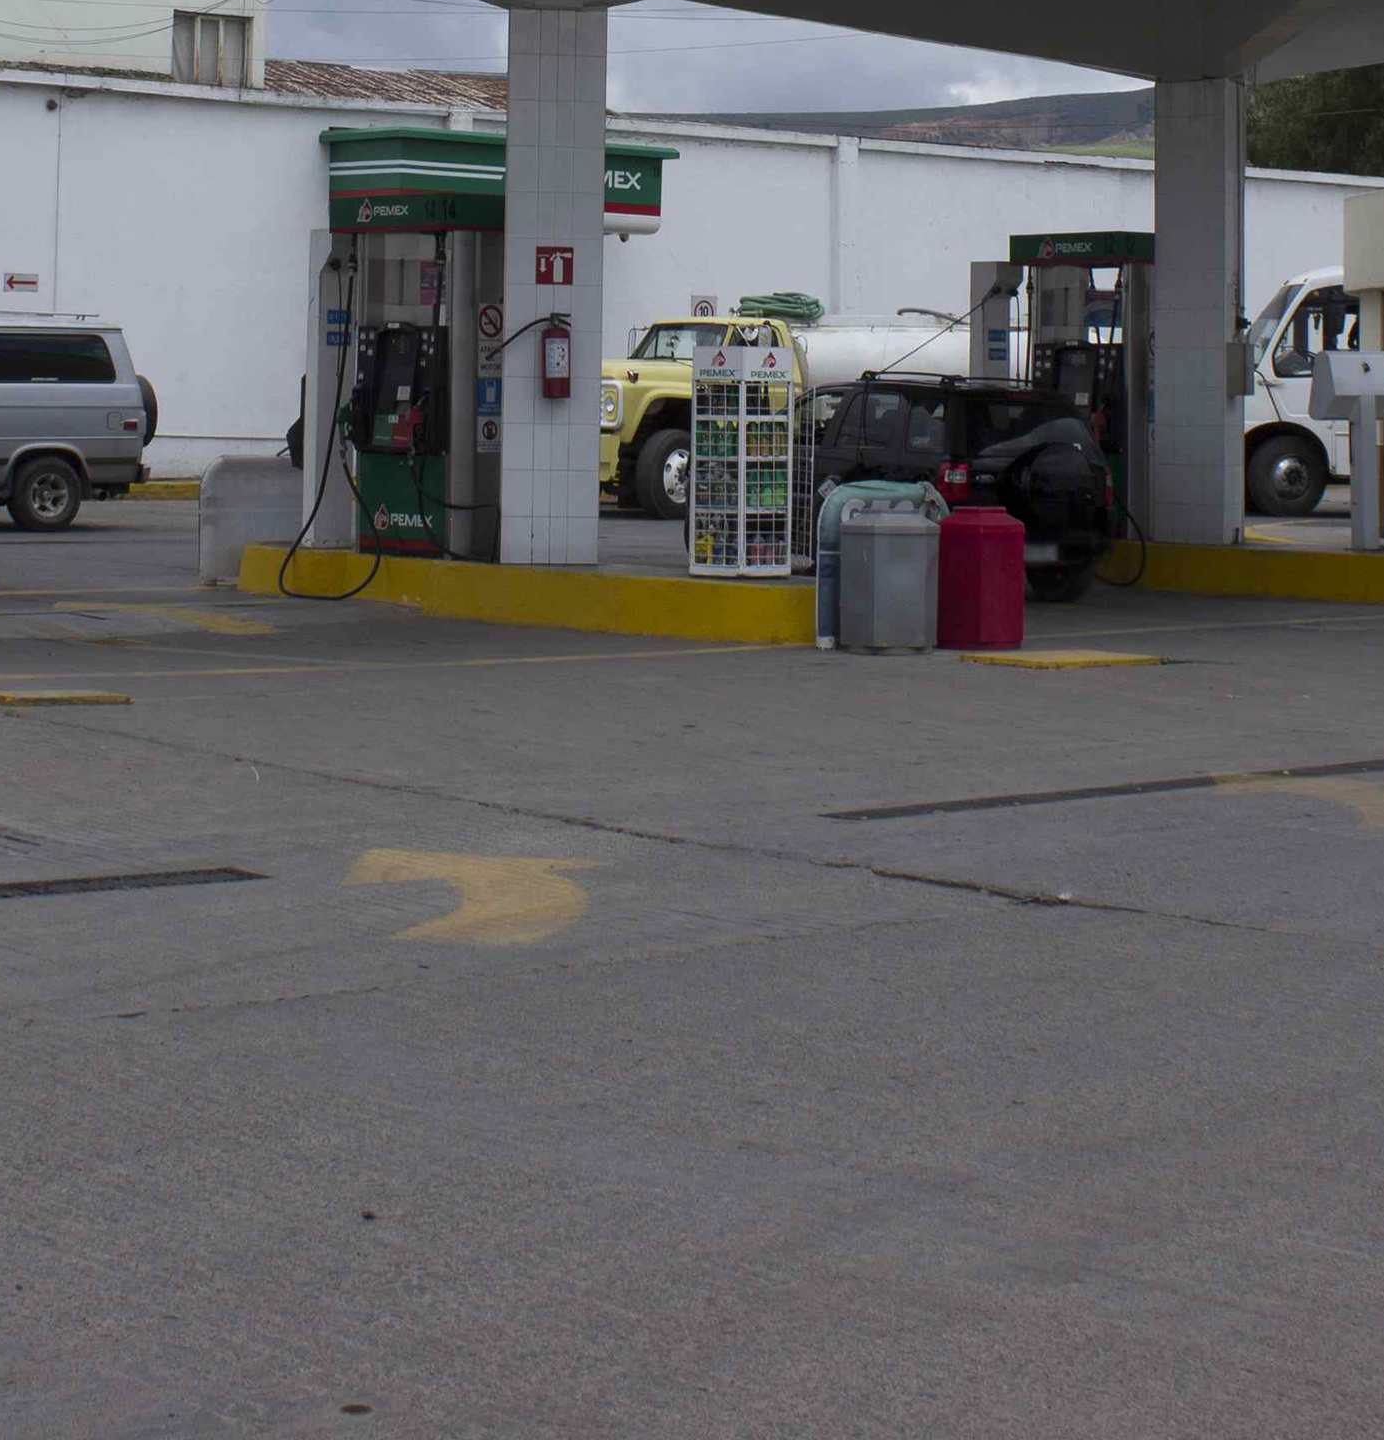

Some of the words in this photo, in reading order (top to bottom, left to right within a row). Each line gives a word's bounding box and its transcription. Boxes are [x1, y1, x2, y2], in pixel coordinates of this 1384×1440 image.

[373, 205, 409, 216] PEMEX
[1055, 242, 1093, 254] PEMEX
[699, 306, 709, 317] 10
[699, 369, 736, 378] PEMEX
[750, 370, 786, 379] PEMEX
[390, 513, 433, 528] PEMEX
